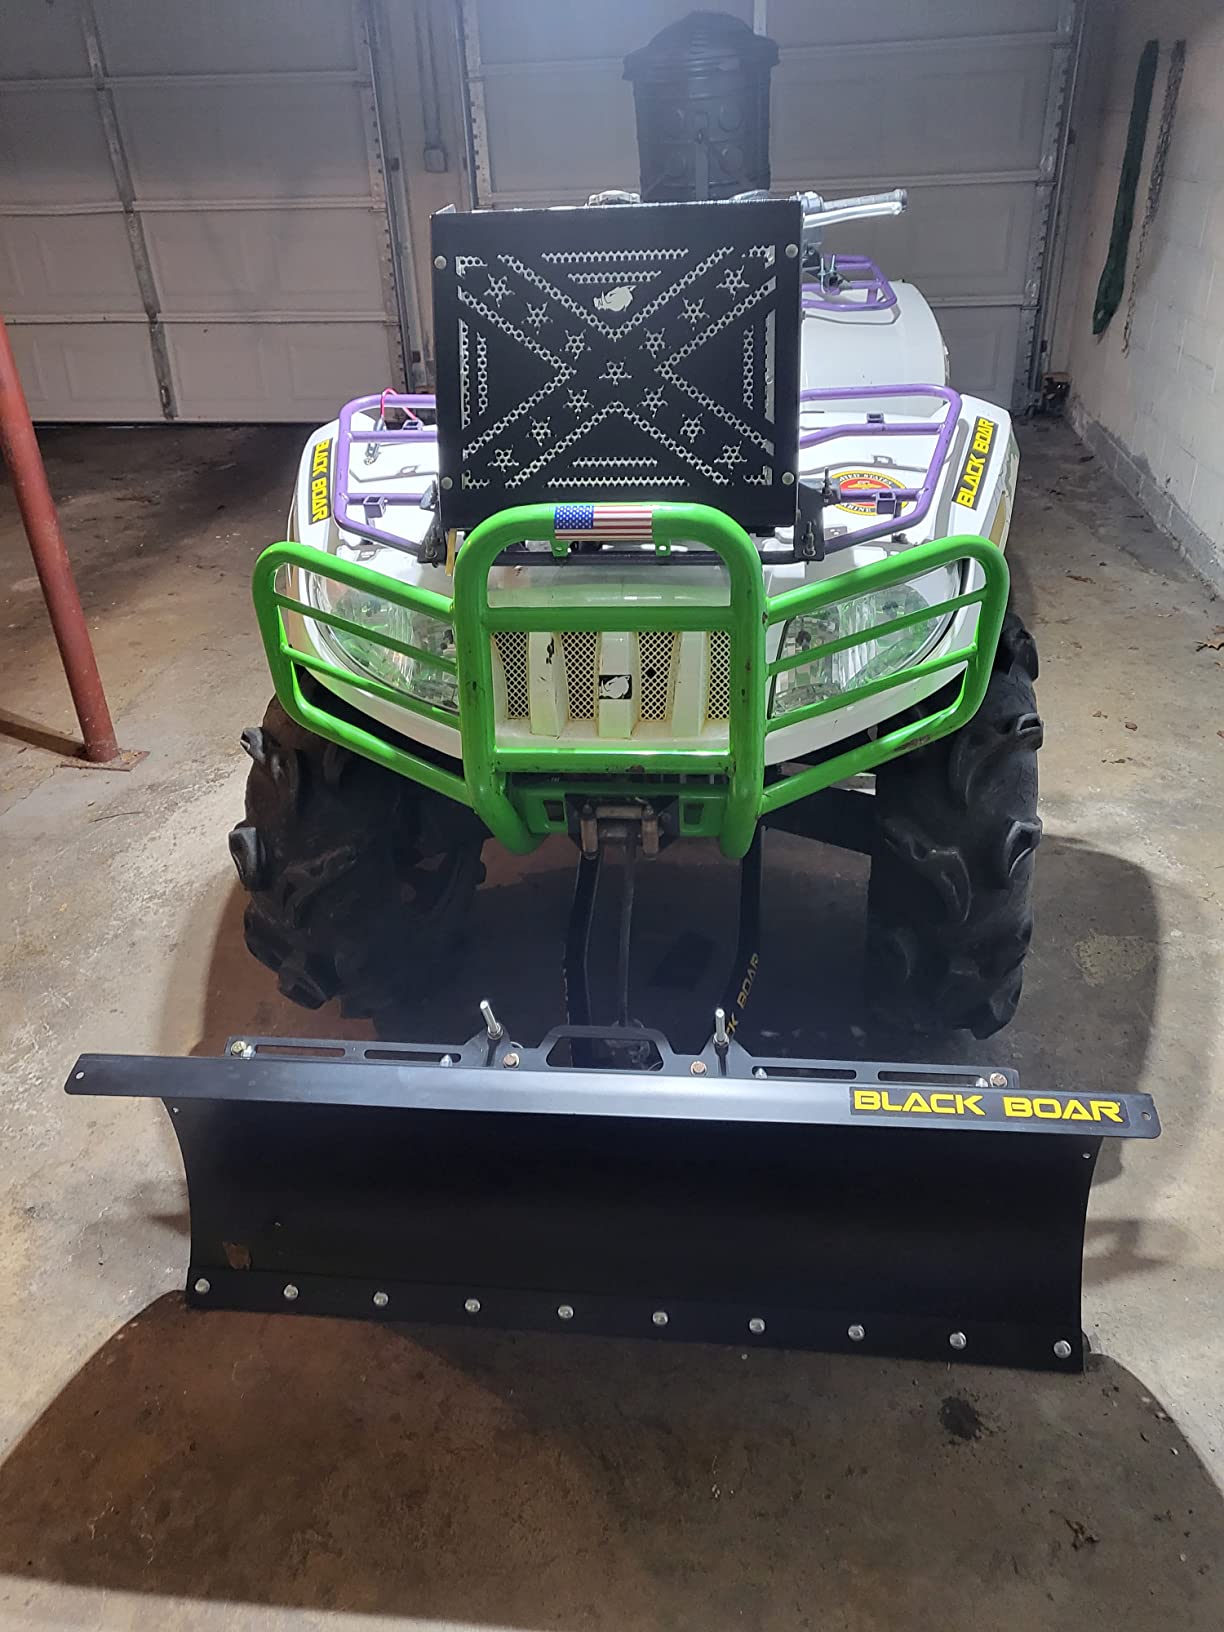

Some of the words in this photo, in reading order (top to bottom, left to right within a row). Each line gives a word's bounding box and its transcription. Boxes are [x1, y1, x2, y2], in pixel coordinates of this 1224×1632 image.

[312, 439, 330, 477] BLACK
[956, 453, 986, 508] BLACK
[972, 417, 995, 454] BOAR
[311, 476, 329, 523] BOAR
[853, 1090, 986, 1116] BLACK
[1002, 1096, 1124, 1123] BOAR
